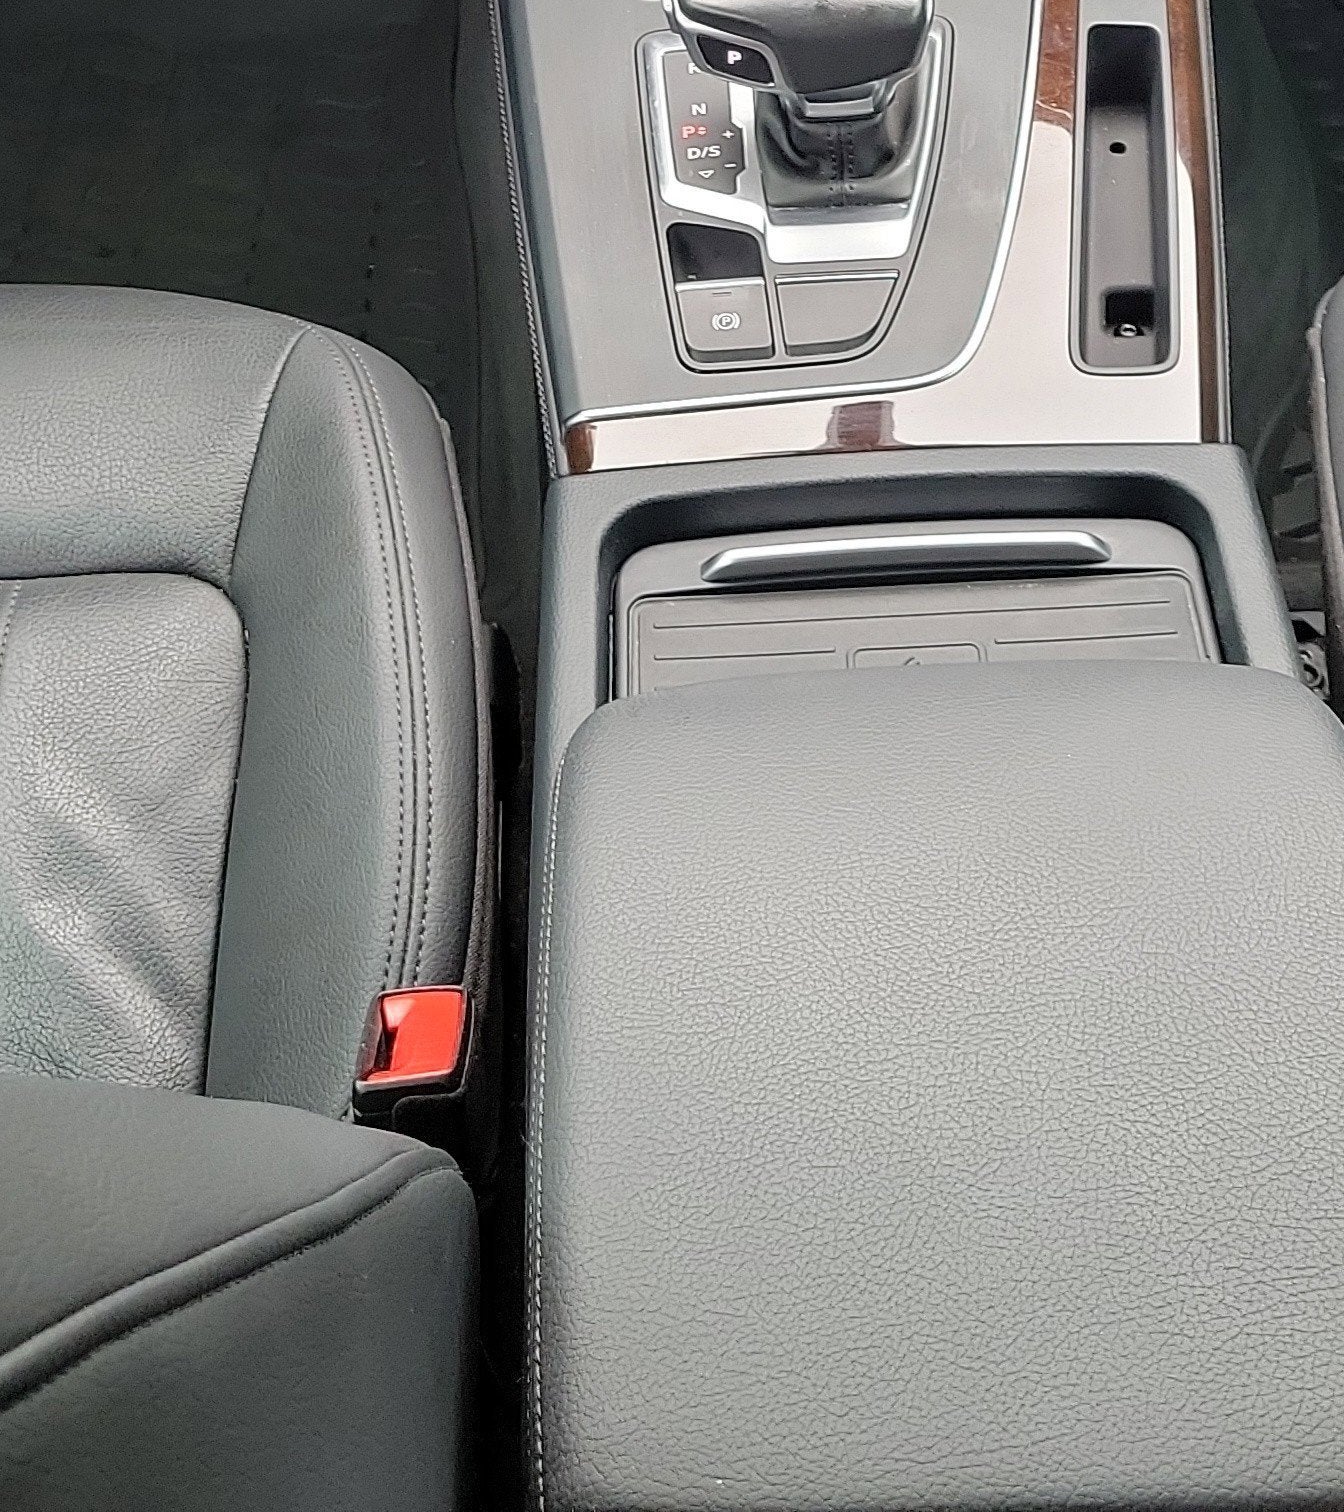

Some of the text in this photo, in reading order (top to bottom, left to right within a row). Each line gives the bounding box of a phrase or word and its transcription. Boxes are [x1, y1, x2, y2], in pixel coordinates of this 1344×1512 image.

[726, 50, 743, 65] P
[690, 102, 708, 116] N
[681, 125, 696, 139] P
[686, 145, 722, 160] D/S
